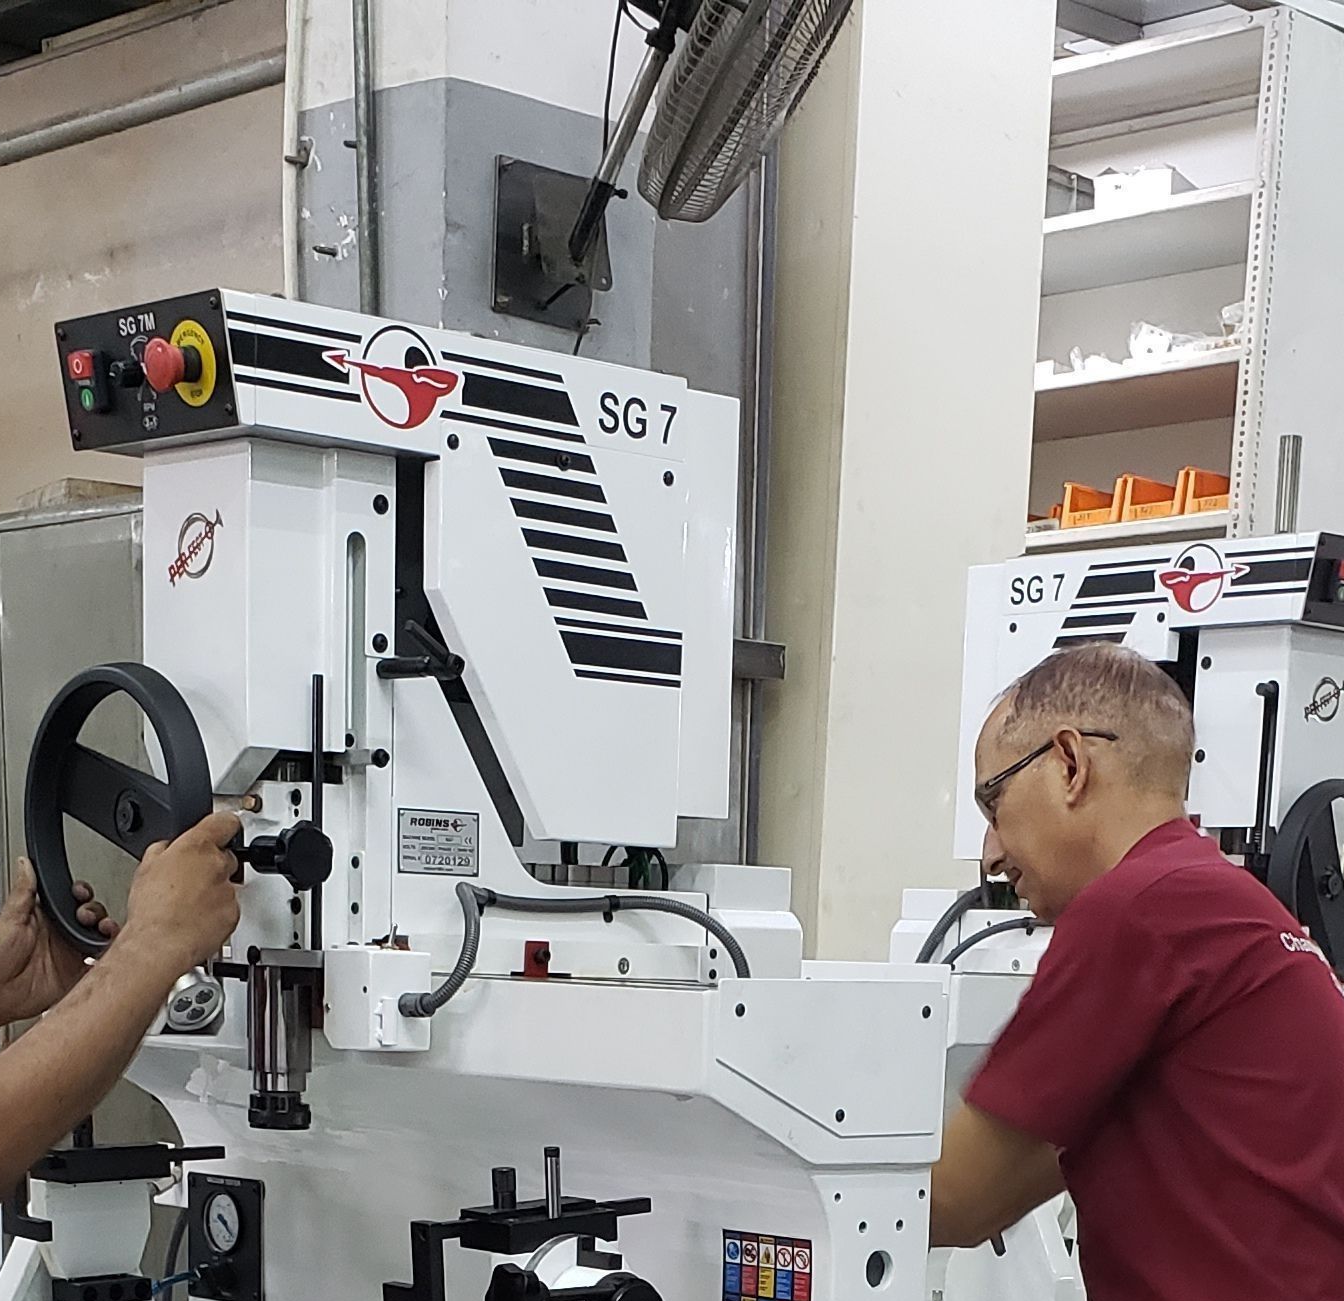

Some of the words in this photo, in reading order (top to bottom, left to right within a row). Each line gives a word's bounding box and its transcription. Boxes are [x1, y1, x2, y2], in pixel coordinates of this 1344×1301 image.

[118, 317, 137, 337] SG
[138, 312, 156, 331] 7M
[598, 391, 647, 439] SG
[660, 404, 677, 444] 7
[1010, 575, 1043, 605] SG
[1053, 573, 1065, 601] 7
[410, 817, 450, 828] ROBINS
[425, 855, 471, 867] 0720129
